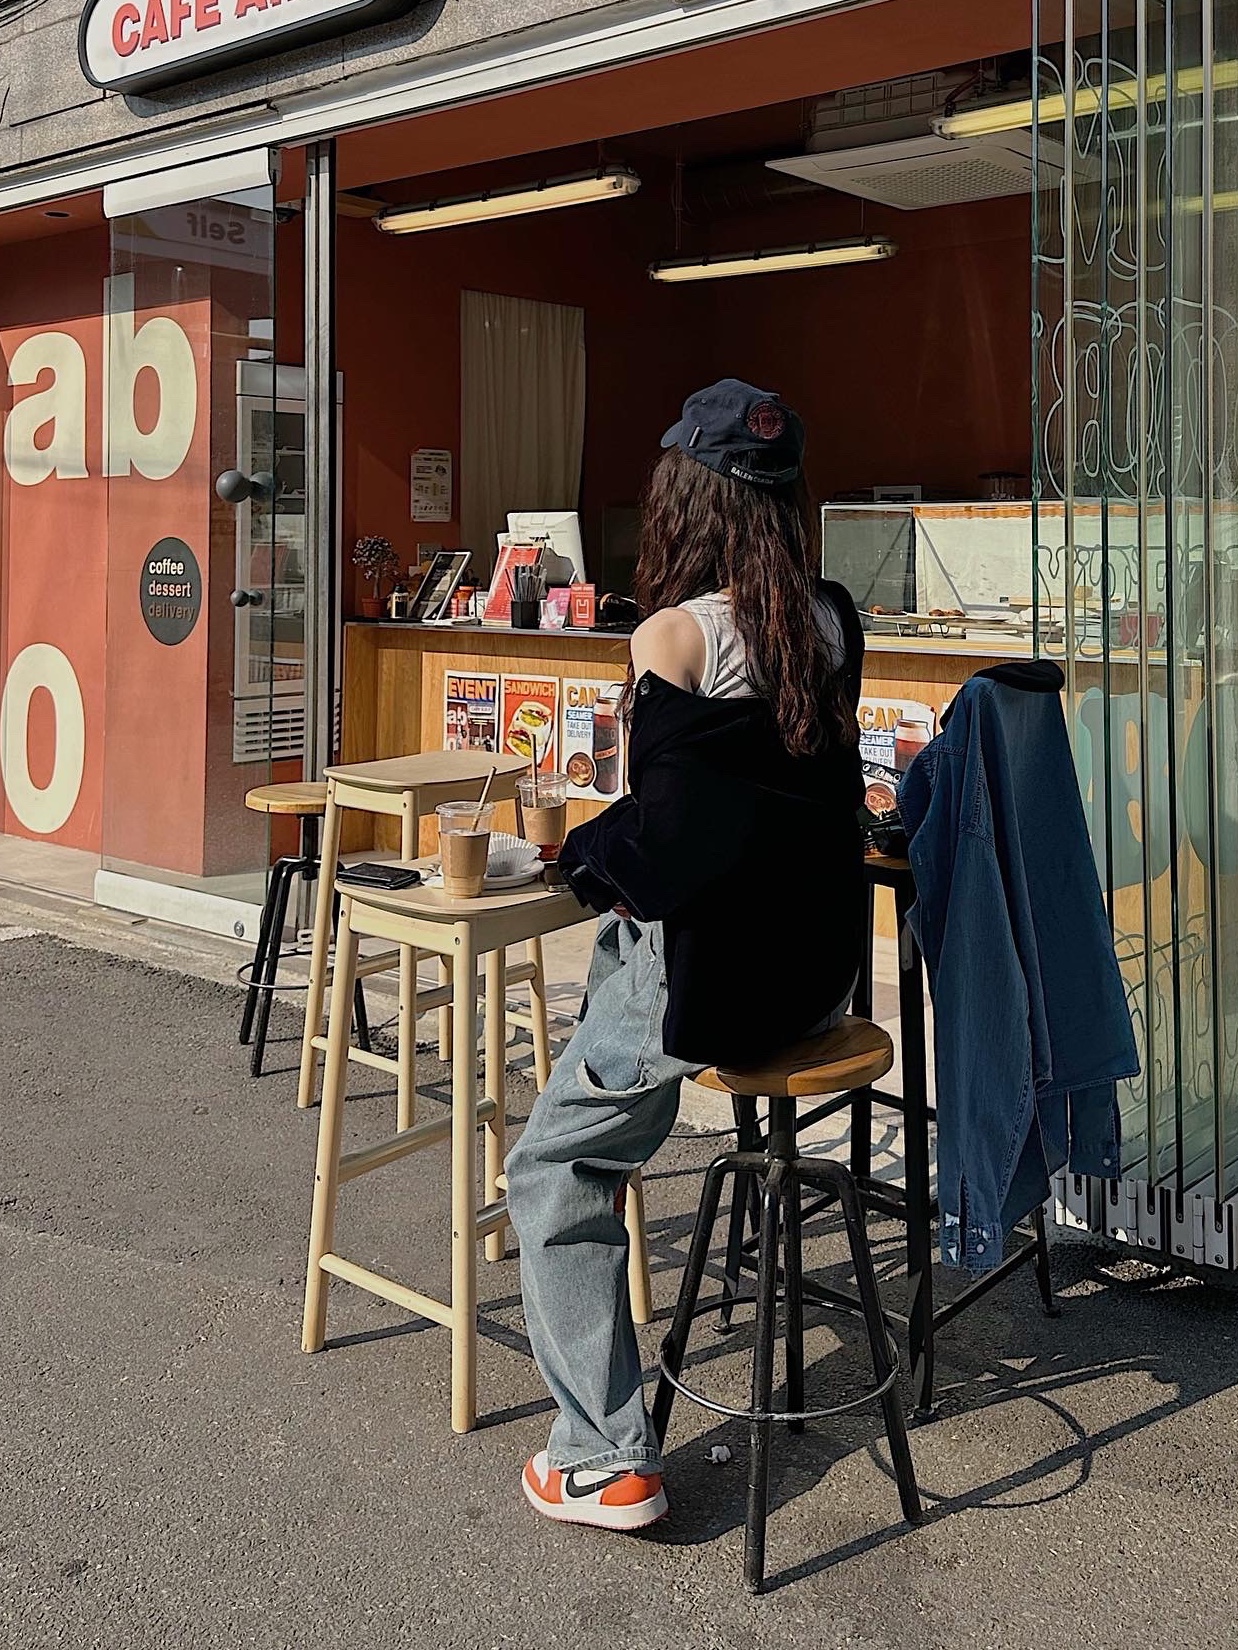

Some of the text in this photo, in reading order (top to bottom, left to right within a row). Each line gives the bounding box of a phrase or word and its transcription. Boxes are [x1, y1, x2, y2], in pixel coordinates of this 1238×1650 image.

[112, 0, 221, 57] CAFE
[148, 558, 185, 575] coffee
[148, 580, 192, 598] dessert
[148, 602, 196, 622] delivery
[448, 678, 495, 700] EVENT
[505, 681, 555, 696] SANDWICH
[567, 686, 600, 708] CAN
[566, 721, 592, 731] TAKE OUT
[859, 706, 903, 731] CAN
[566, 729, 592, 739] DELIVERY
[861, 747, 893, 757] TAKE OUT
